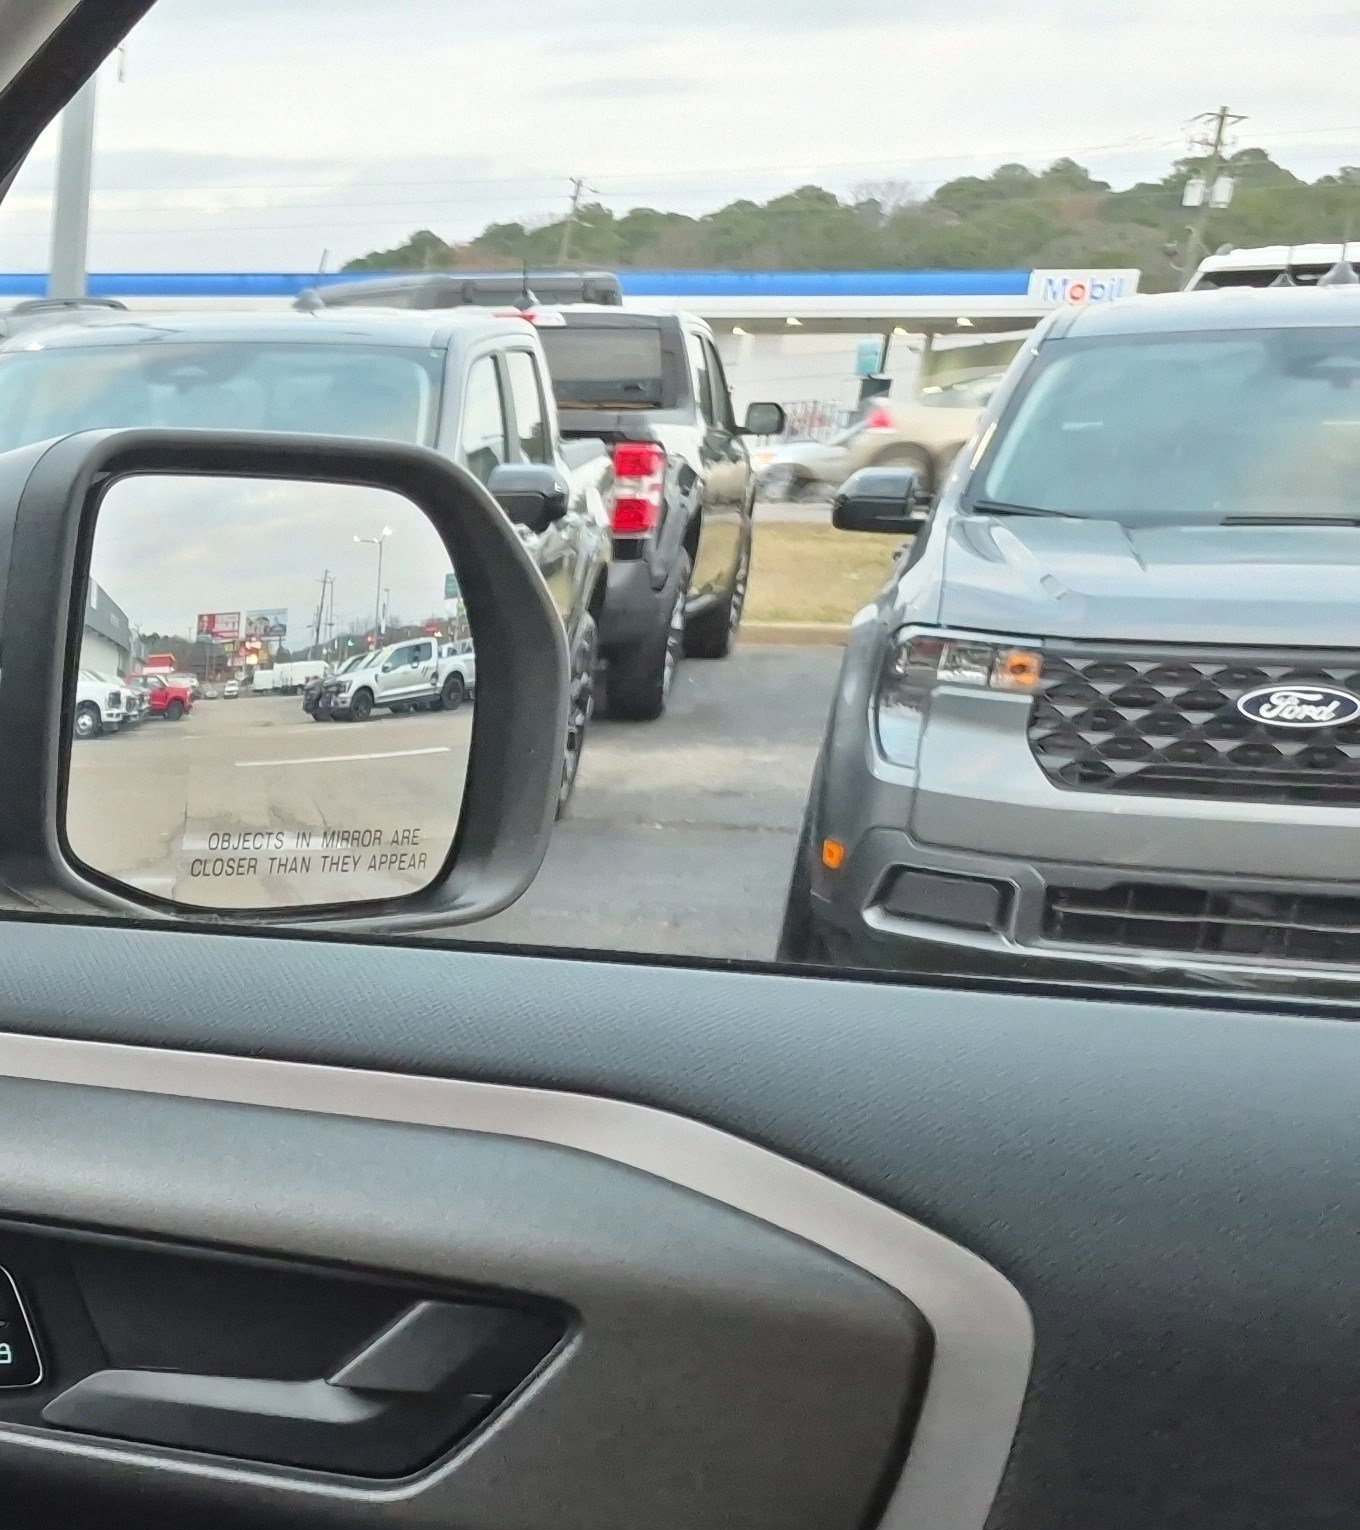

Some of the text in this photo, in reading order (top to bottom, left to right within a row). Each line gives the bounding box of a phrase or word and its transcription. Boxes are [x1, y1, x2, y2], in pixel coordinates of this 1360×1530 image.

[1044, 276, 1125, 301] Mobil
[1259, 691, 1341, 721] Ford
[208, 828, 421, 851] OBJECTS IN MIRROR ARE
[190, 852, 428, 877] CLOSER THAN THEY APPEAR
